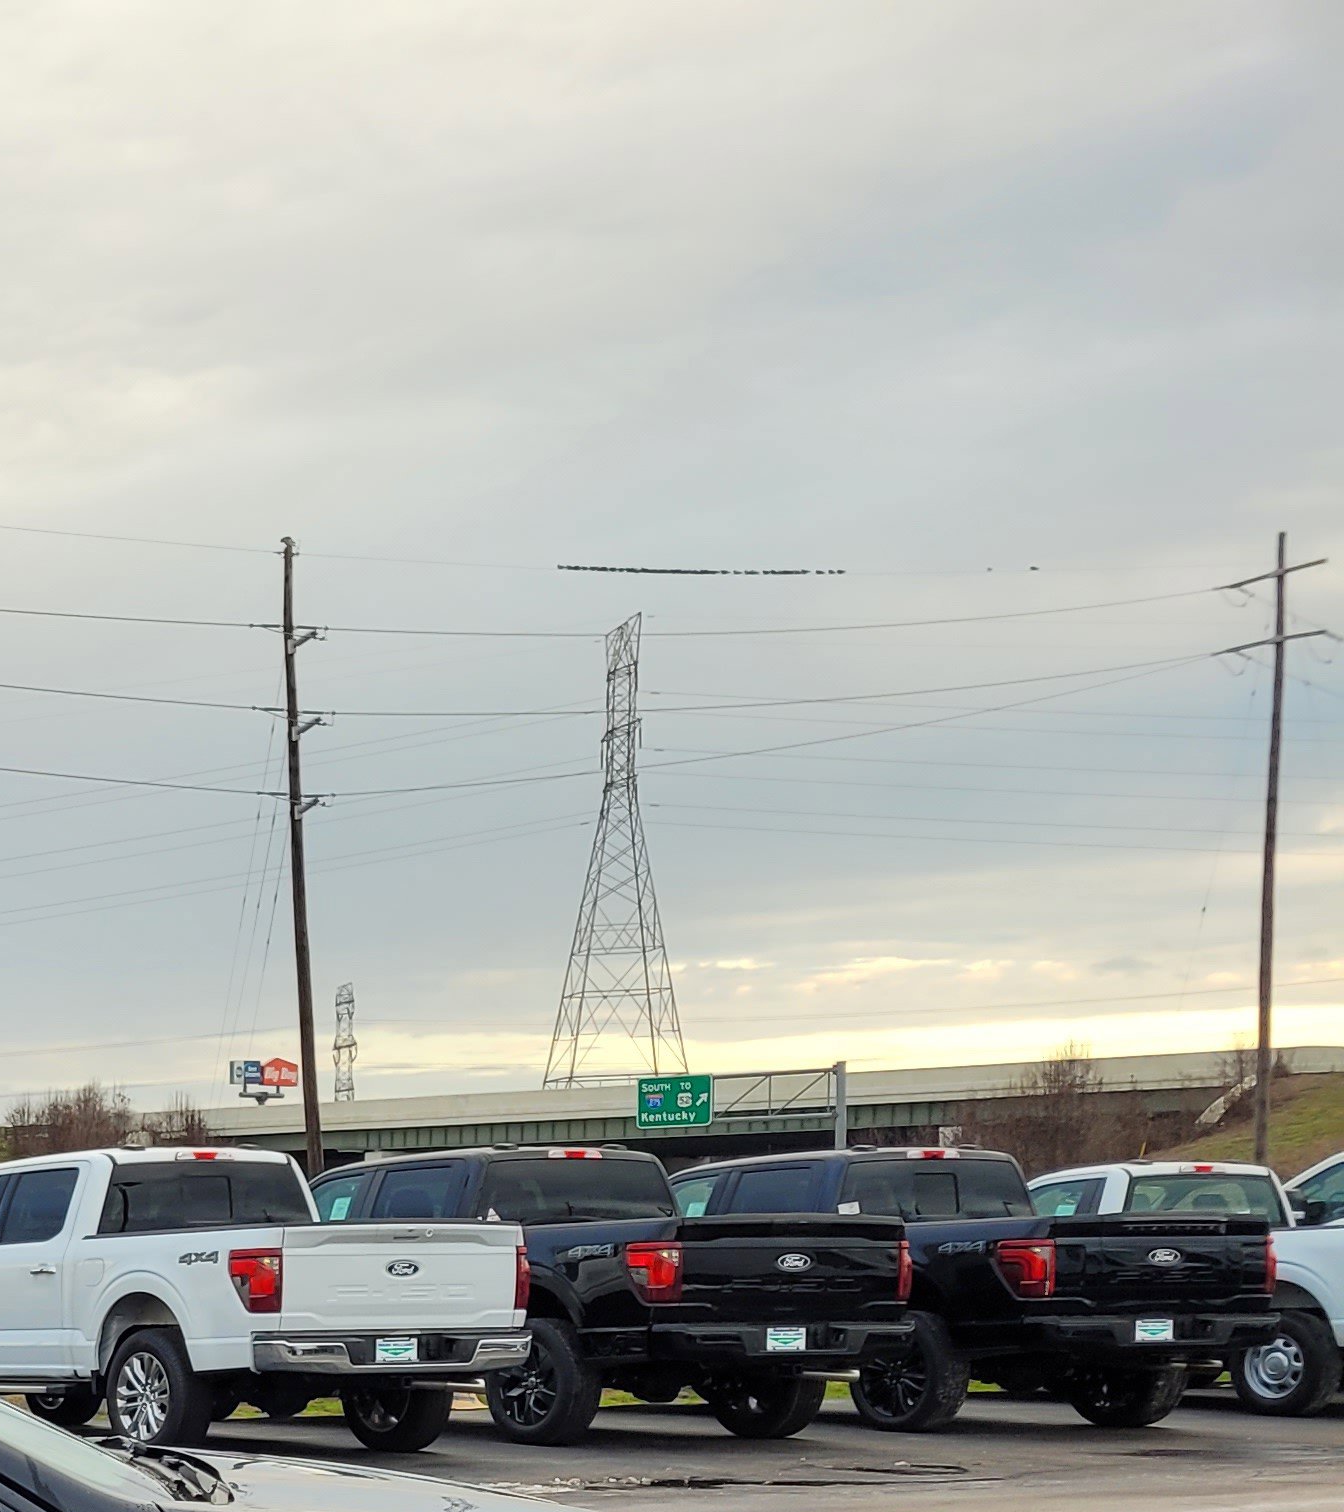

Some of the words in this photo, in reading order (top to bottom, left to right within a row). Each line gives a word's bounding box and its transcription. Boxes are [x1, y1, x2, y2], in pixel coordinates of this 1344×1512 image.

[641, 1083, 671, 1092] SOUTH
[680, 1082, 691, 1090] TO
[641, 1111, 696, 1122] Kentucky
[391, 1263, 415, 1275] Ford
